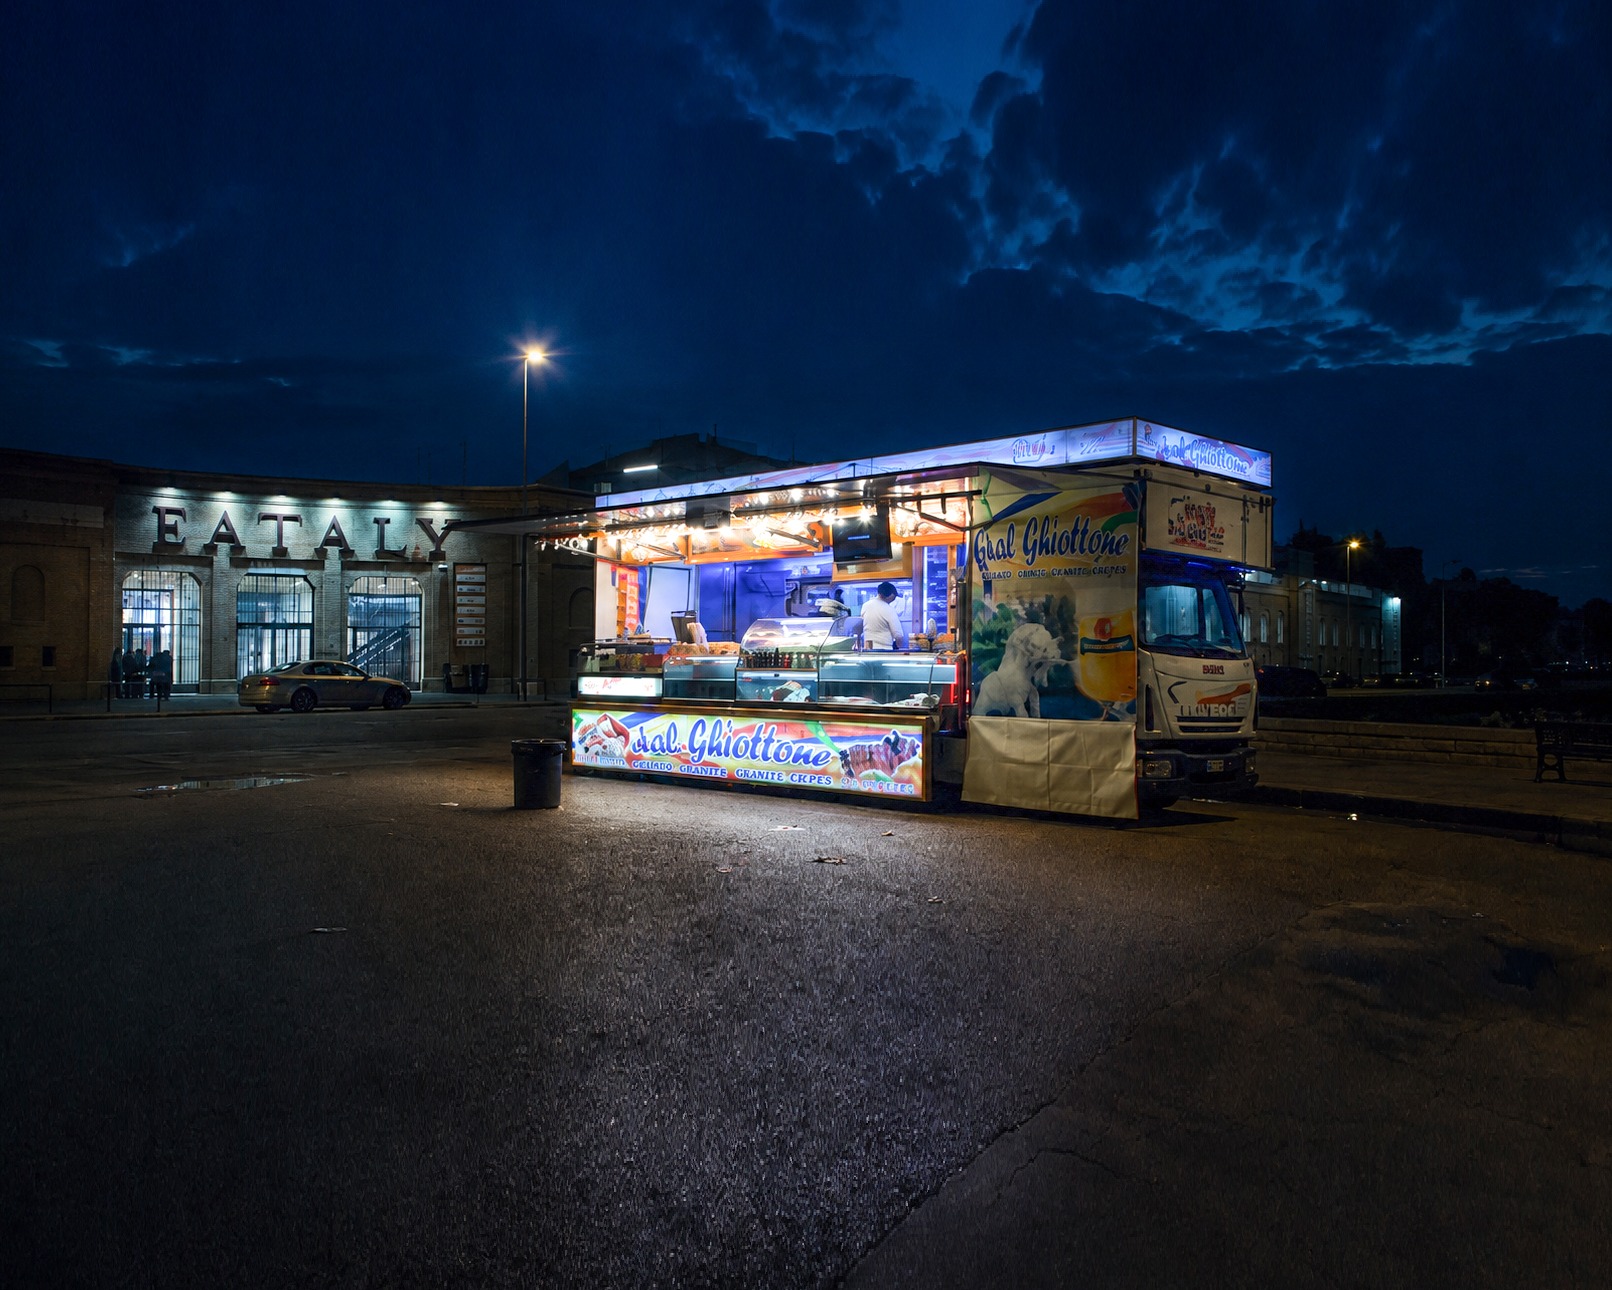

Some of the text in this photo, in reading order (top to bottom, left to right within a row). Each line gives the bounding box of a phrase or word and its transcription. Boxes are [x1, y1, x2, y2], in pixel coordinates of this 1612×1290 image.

[151, 505, 461, 561] EATALY
[687, 718, 832, 767] Ghiottone
[735, 768, 784, 782] GRANITE
